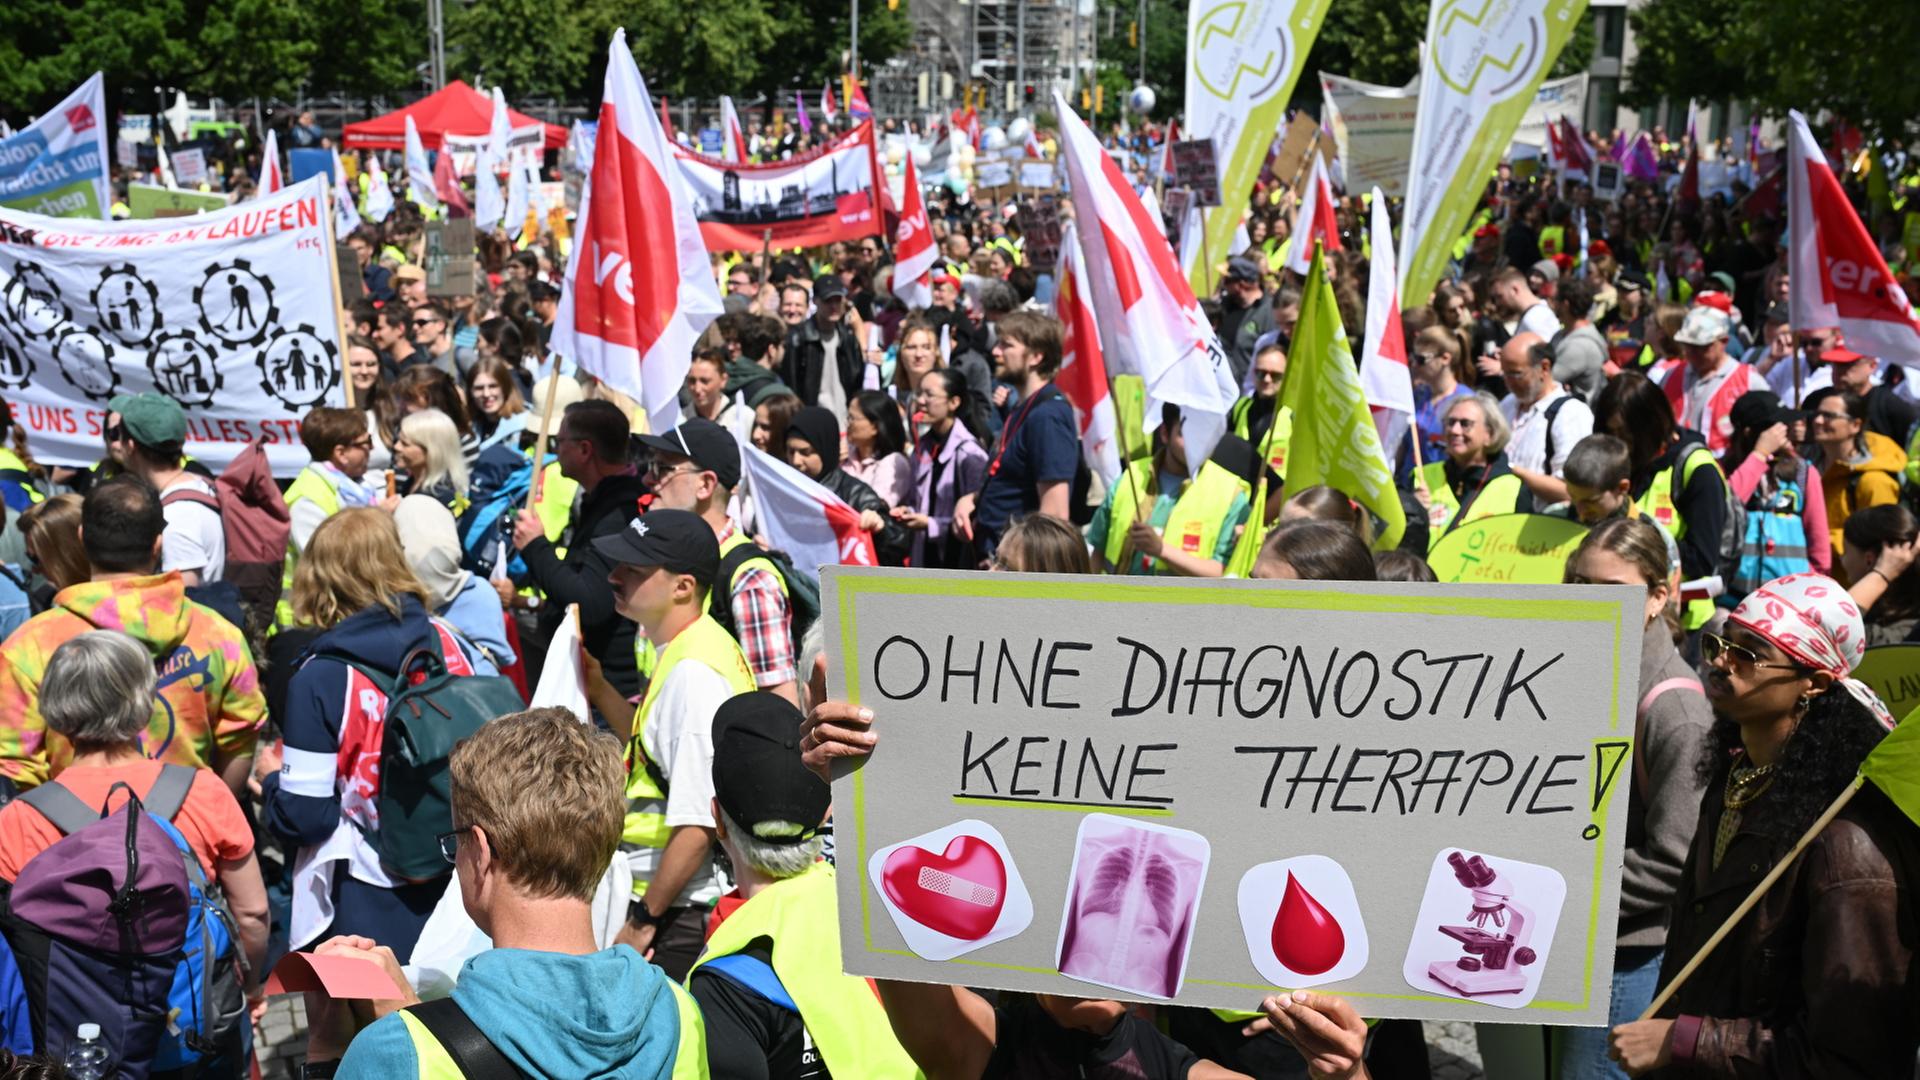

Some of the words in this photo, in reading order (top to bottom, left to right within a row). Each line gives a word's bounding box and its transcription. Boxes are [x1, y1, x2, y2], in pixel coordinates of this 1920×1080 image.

[207, 197, 318, 240] LAUFEN
[28, 404, 78, 434] UNS
[1460, 552, 1517, 581] Total
[873, 634, 1093, 709] OHNE
[1110, 636, 1565, 721] DIAGNOSTIK
[960, 730, 1178, 806] KEINE
[1234, 741, 1630, 841] THERAPIE!
